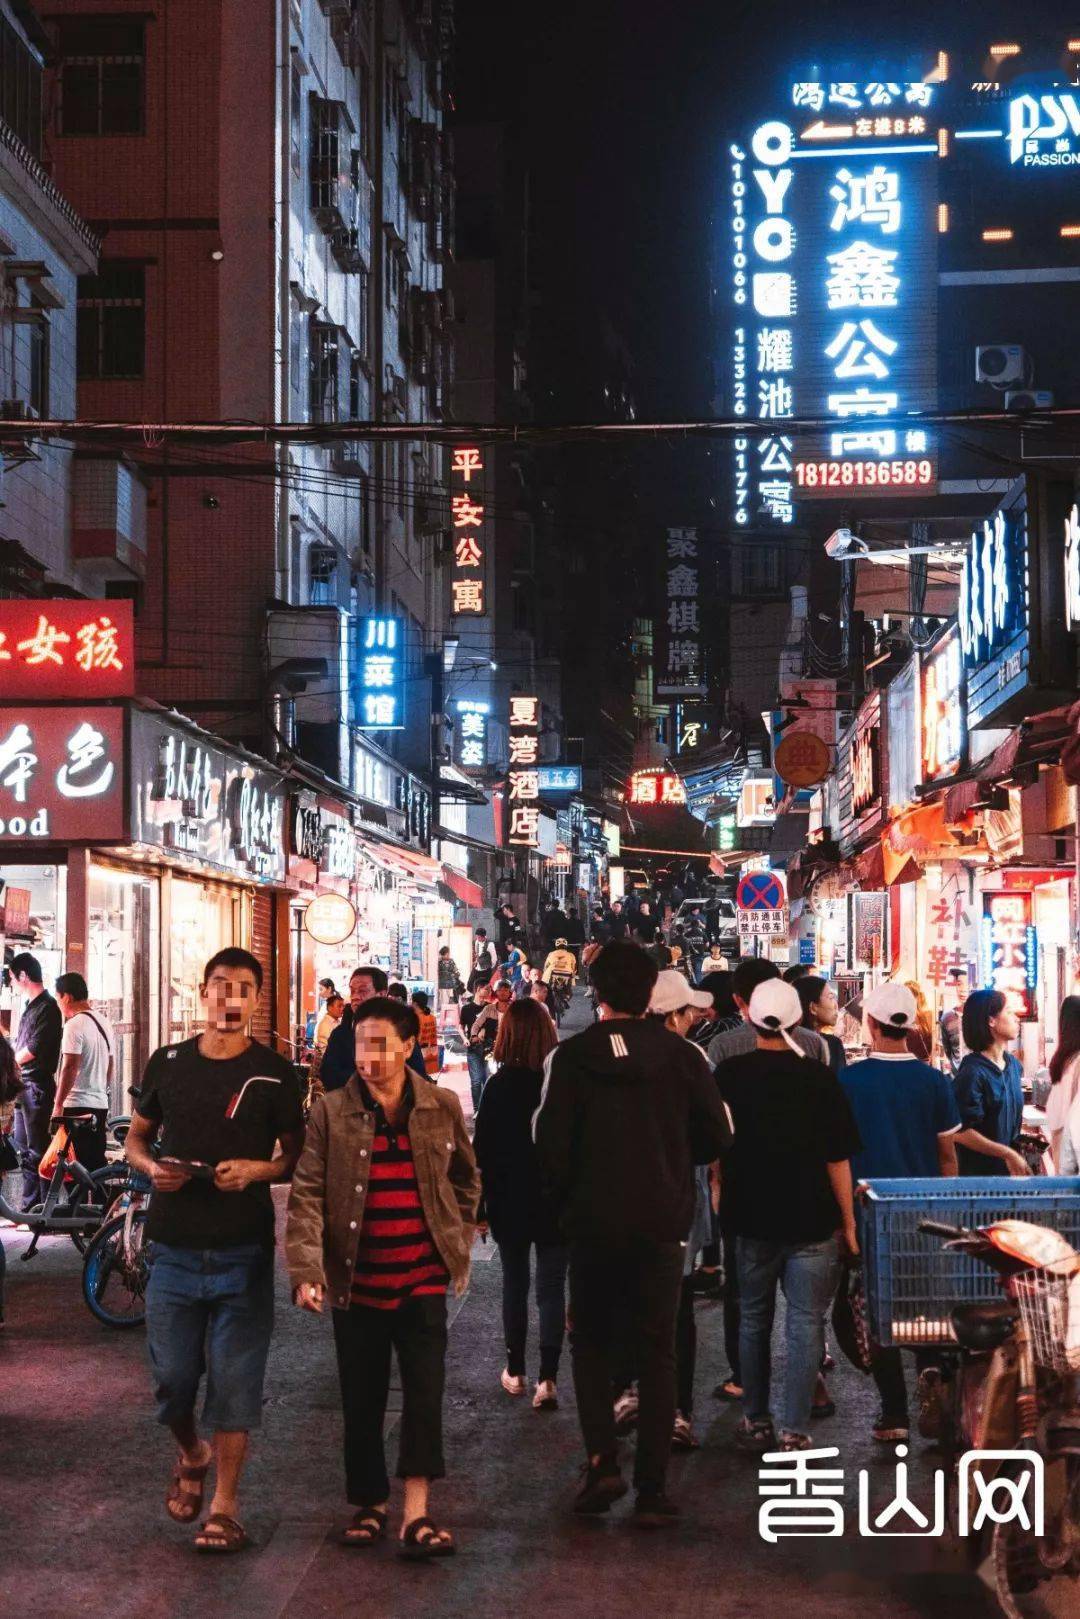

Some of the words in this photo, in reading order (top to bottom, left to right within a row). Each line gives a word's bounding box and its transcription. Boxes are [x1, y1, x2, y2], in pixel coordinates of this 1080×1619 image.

[731, 163, 748, 305] 10101066
[752, 121, 793, 262] OYO
[824, 166, 902, 456] 鸿鑫公寓
[733, 328, 748, 525] 1332601776
[756, 328, 793, 523] 耀池公寓
[795, 460, 932, 487] 18128136589
[451, 448, 485, 613] 平安公寓
[0, 614, 123, 672] 女孩
[364, 619, 398, 725] 川菜馆
[0, 808, 50, 837] od
[509, 697, 539, 837] 夏湾酒店
[739, 911, 782, 922] 消防通道
[740, 922, 782, 933] 禁止停车
